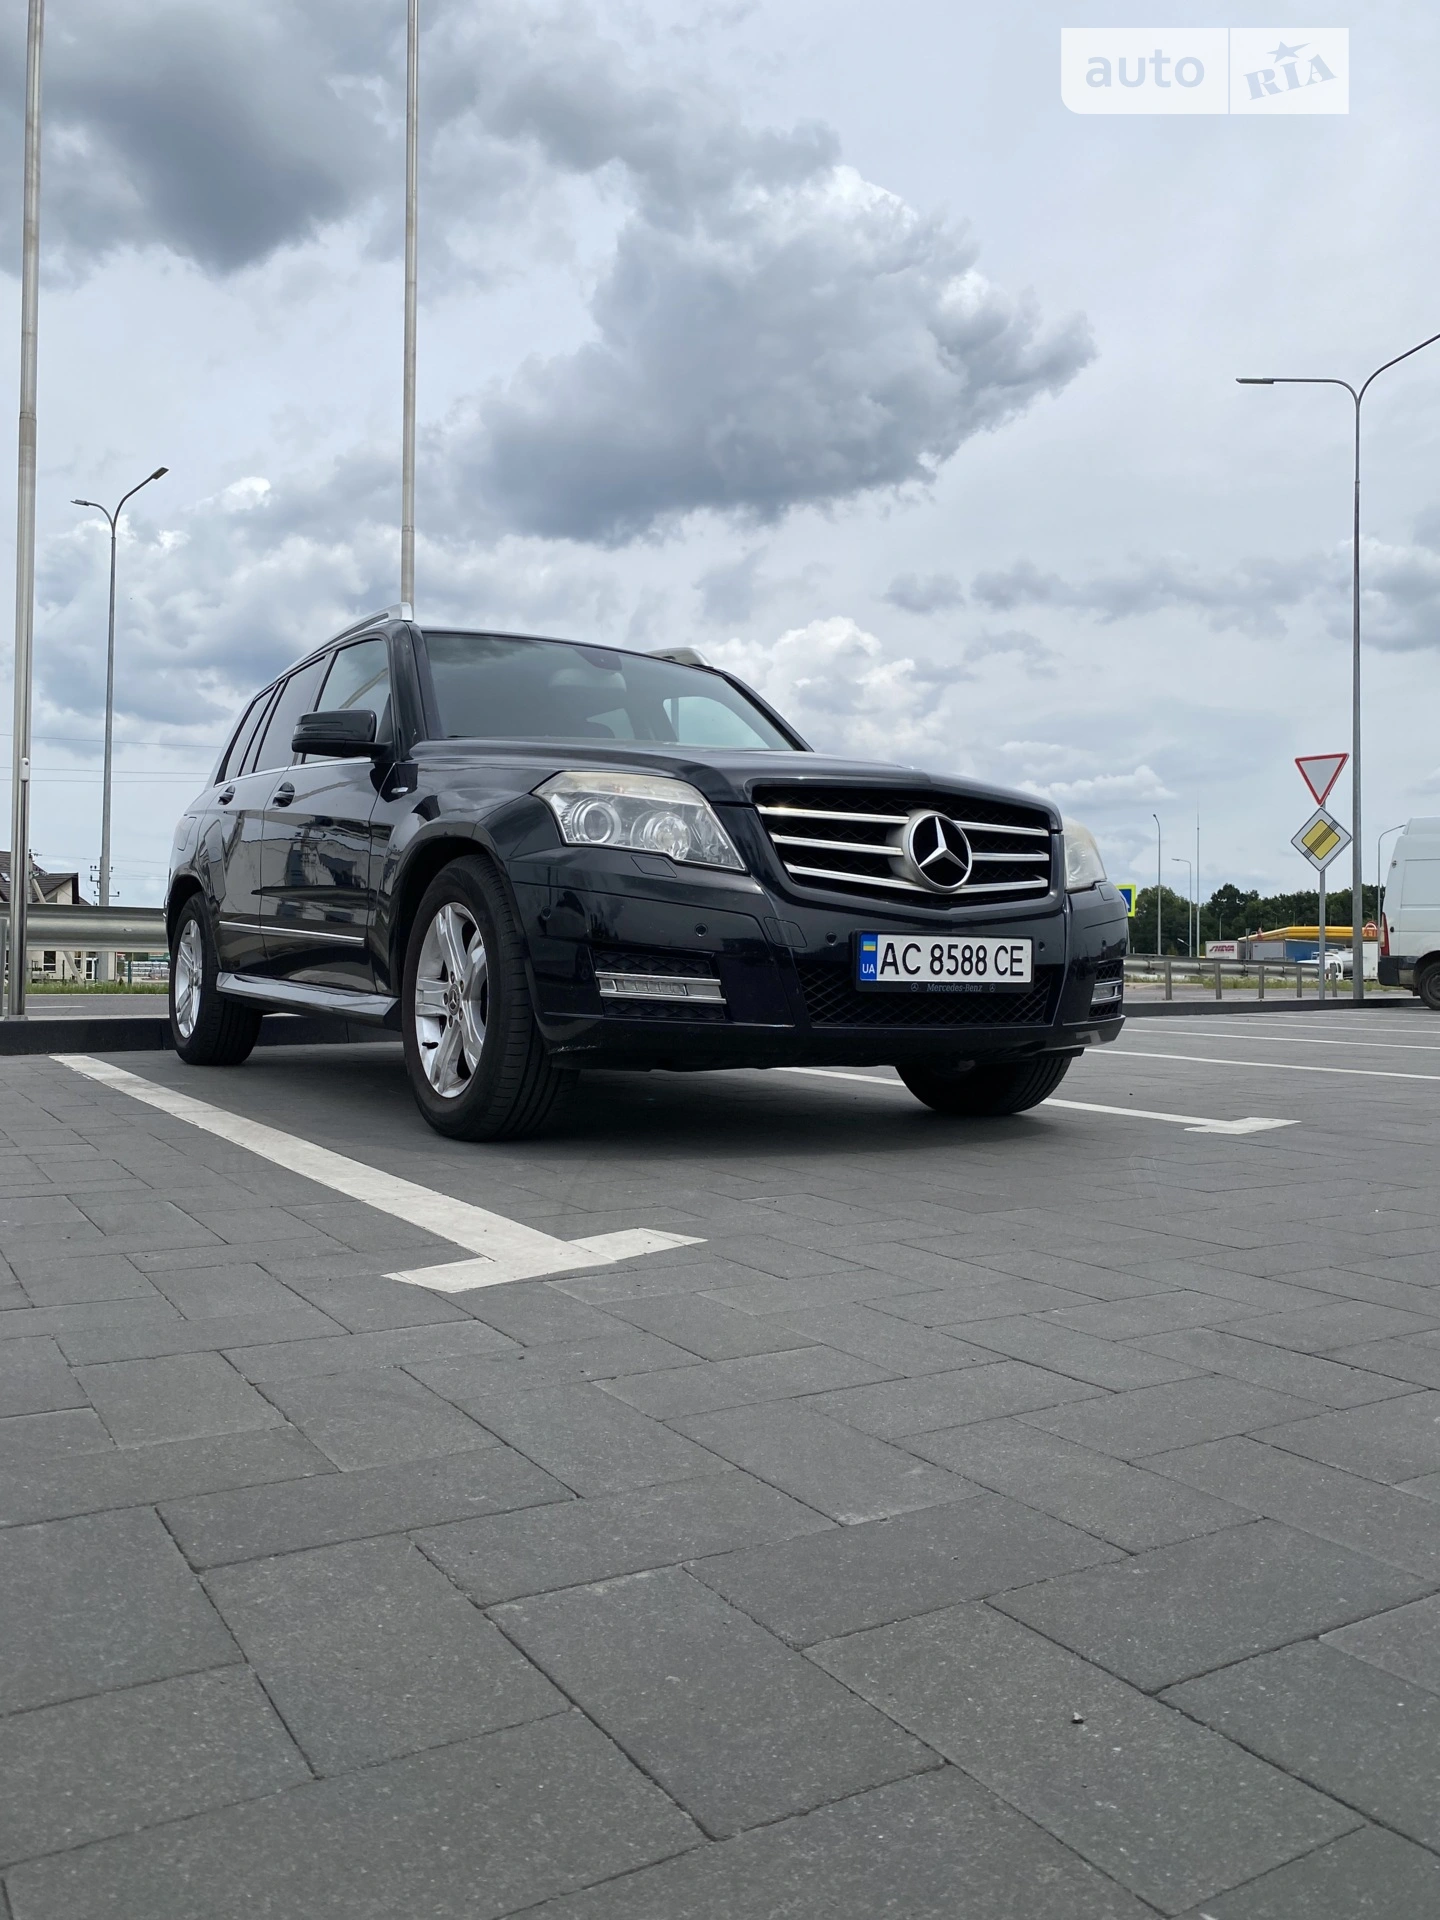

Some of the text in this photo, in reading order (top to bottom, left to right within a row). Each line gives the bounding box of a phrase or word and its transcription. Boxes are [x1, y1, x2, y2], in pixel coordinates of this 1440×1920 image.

[879, 942, 1024, 976] AC 8588 CE
[862, 963, 875, 974] UA
[926, 983, 983, 992] Mercedes-Benz
